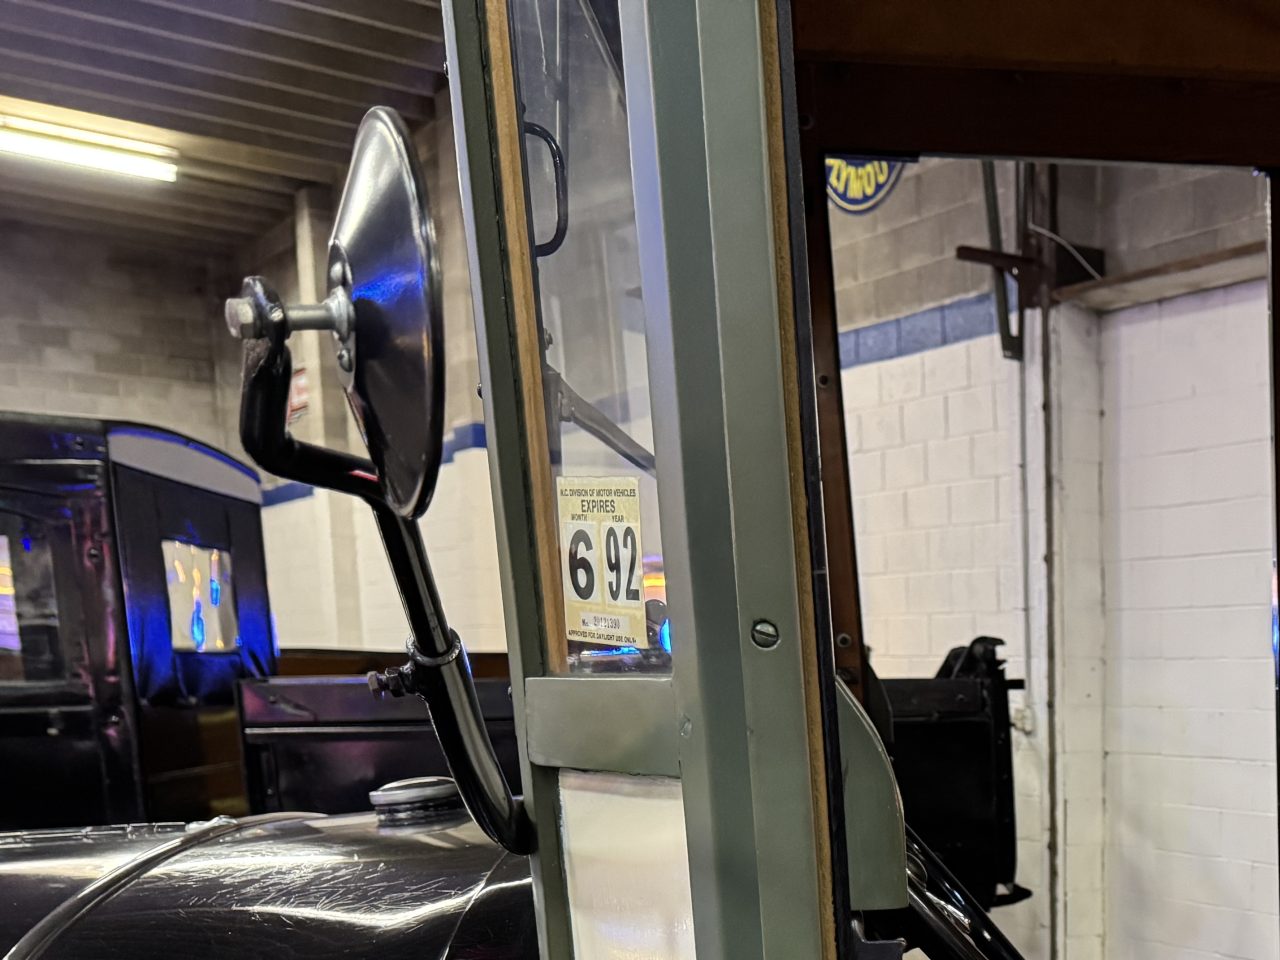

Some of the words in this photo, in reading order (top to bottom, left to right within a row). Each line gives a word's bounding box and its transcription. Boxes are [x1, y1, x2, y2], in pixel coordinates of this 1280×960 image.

[569, 488, 588, 497] DIVISION
[589, 489, 596, 497] OF
[596, 488, 613, 497] MOTOR
[613, 488, 637, 497] VEHICLES
[581, 499, 616, 514] EXPIRES
[571, 513, 588, 522] MONTH
[611, 515, 625, 523] YEAR
[568, 528, 595, 601] 6
[605, 526, 640, 601] 92
[568, 629, 588, 638] APPROVED
